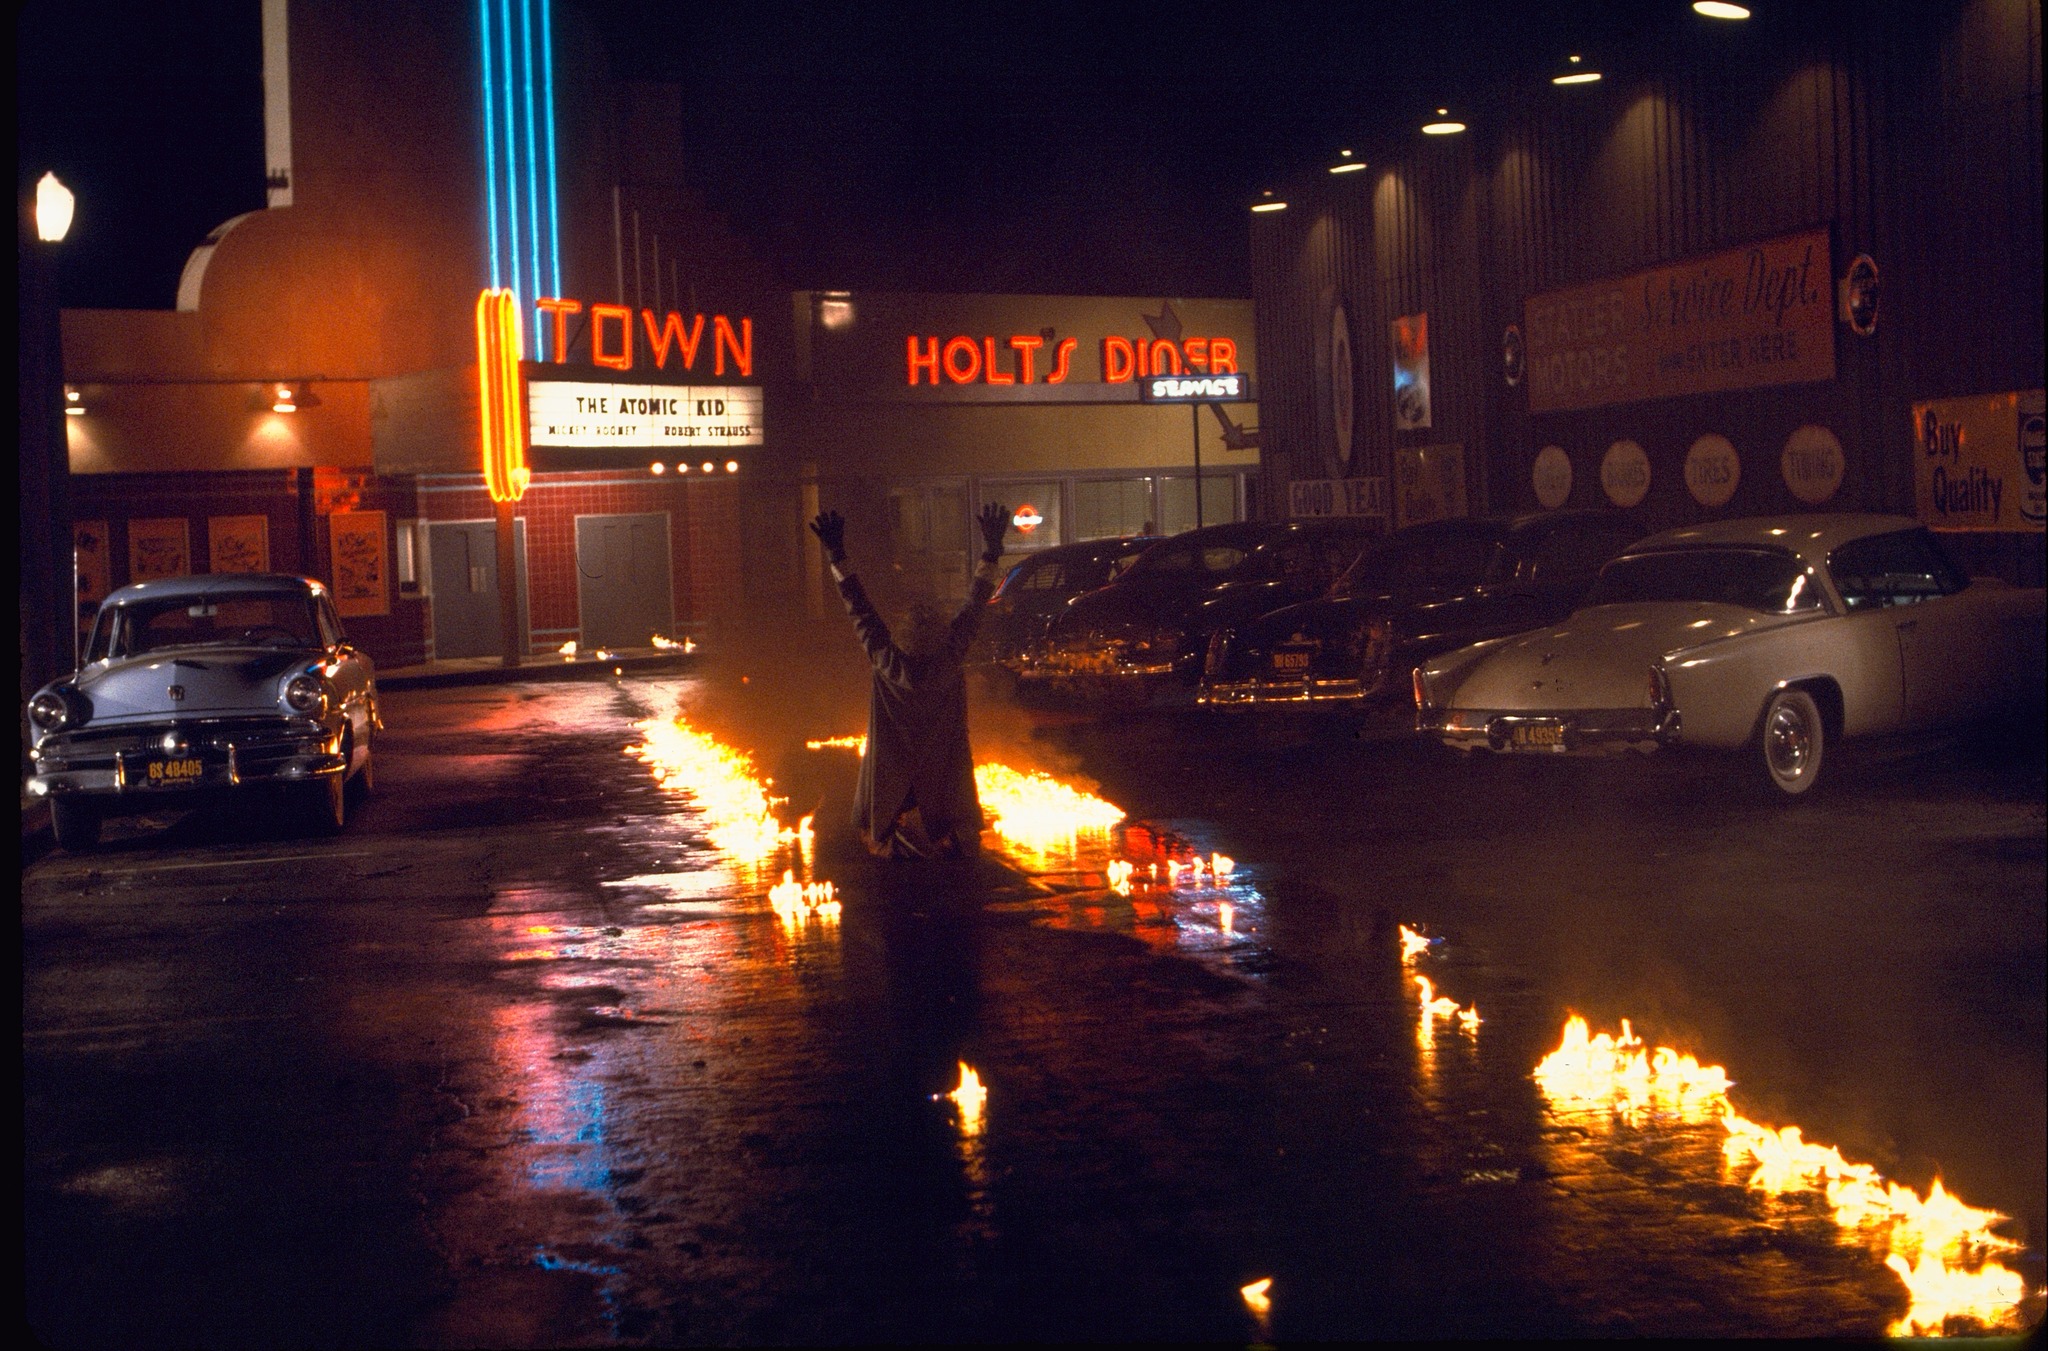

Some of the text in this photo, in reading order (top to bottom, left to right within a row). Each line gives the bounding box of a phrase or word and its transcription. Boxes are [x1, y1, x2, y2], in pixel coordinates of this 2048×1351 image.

[1639, 268, 1733, 331] Service
[1744, 244, 1819, 326] Dept.
[537, 297, 752, 376] TOWN
[1685, 331, 1799, 375] ENTER HERE
[1152, 378, 1240, 397] SERVICE
[1534, 344, 1627, 395] MOTORS
[576, 397, 725, 416] THE ATOMIC KID
[548, 425, 751, 437] MICKEY ROONEY ROBERT STRAUSS
[1925, 410, 1961, 464] Buy
[1690, 455, 1731, 487] TIRES
[1292, 482, 1334, 515] GOOD
[1933, 466, 2002, 524] Quality
[165, 759, 203, 778] 48405
